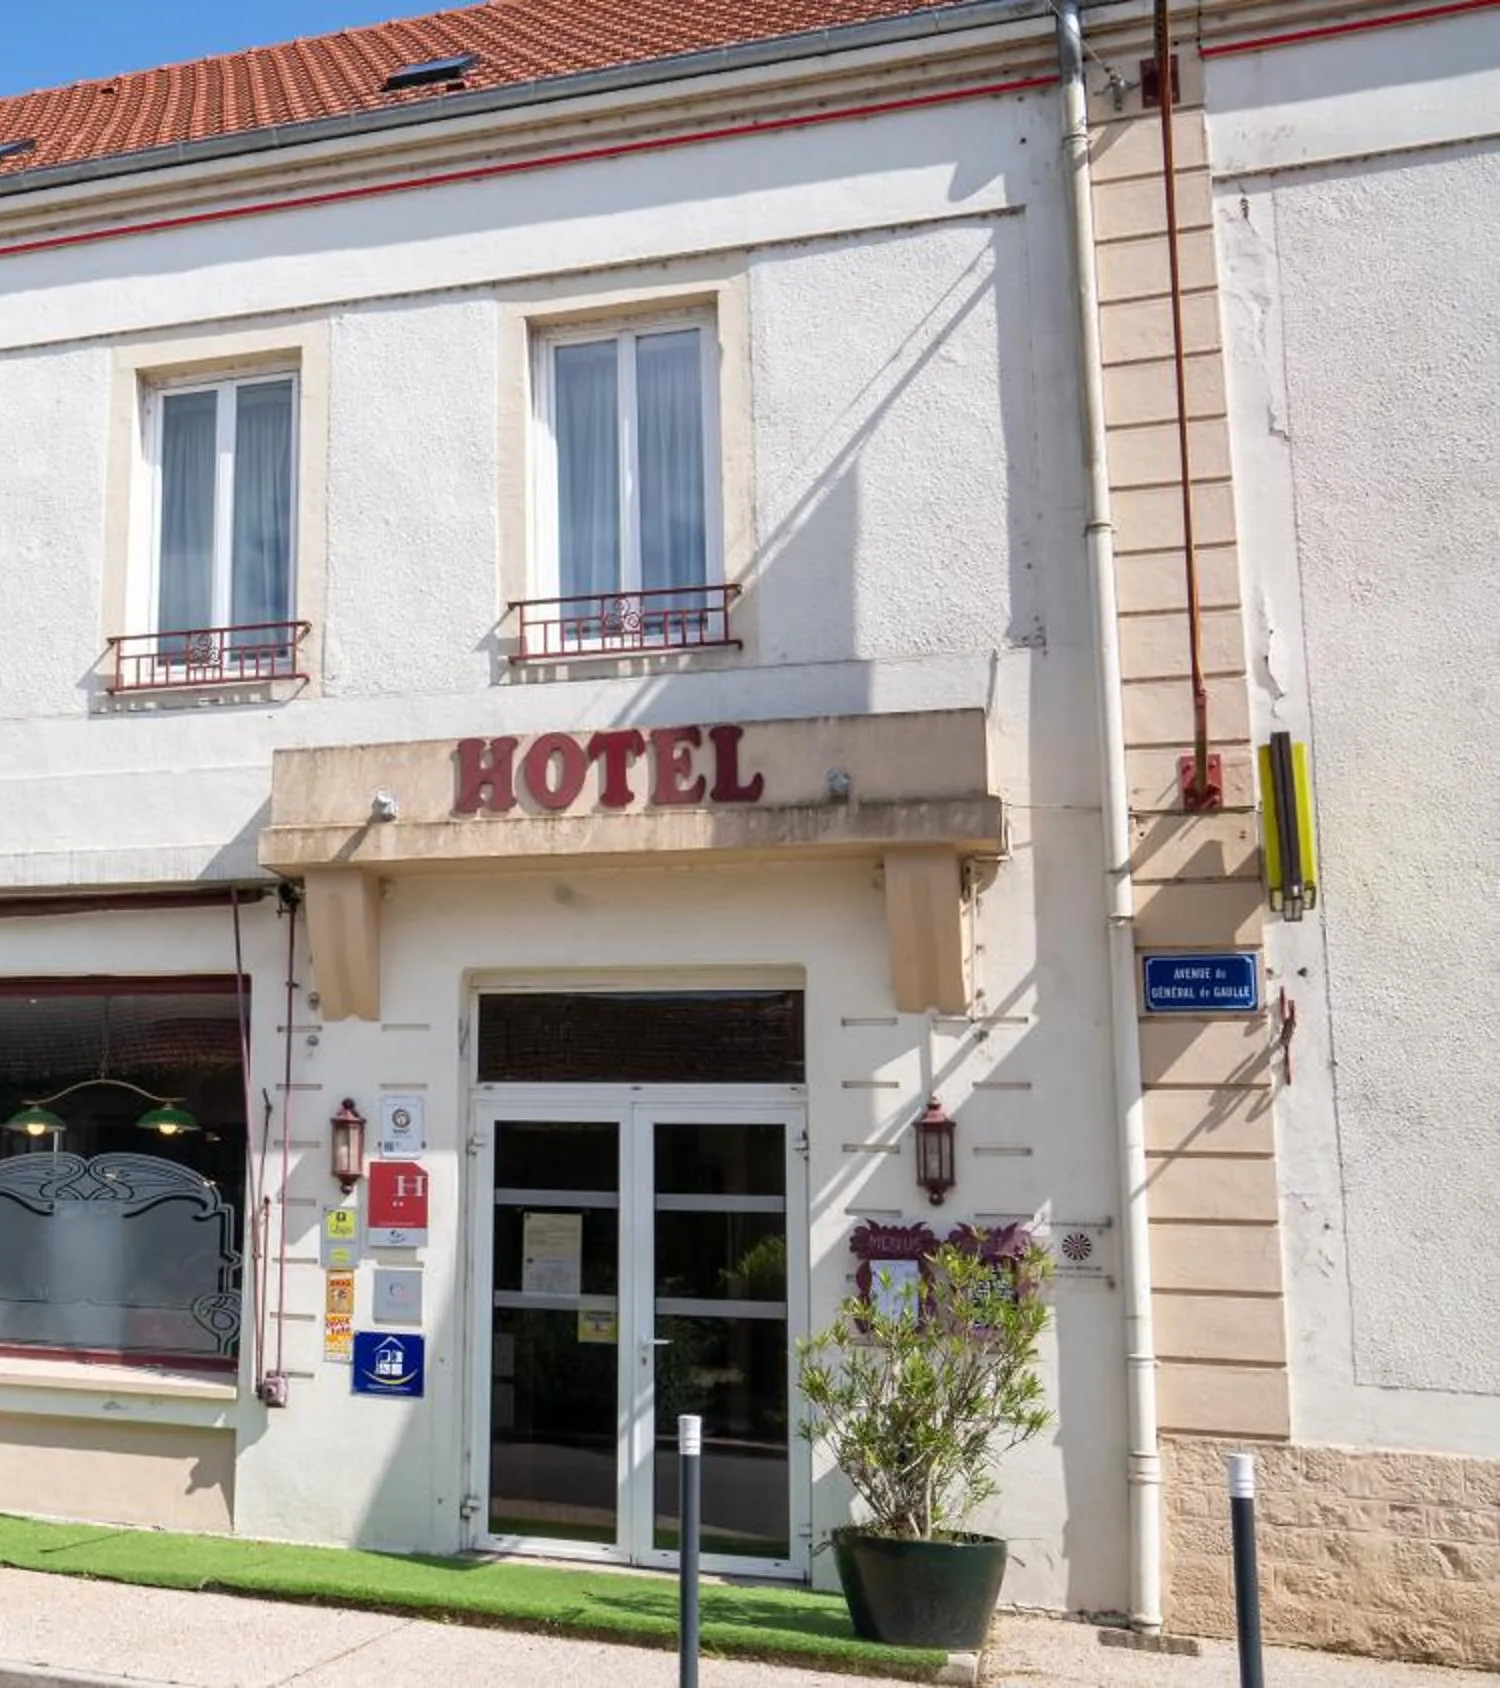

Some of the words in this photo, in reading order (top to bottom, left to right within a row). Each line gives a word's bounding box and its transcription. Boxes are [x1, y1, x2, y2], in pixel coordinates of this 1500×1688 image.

[450, 724, 764, 815] HOTEL
[1173, 967, 1211, 980] AVENUE
[1151, 984, 1195, 999] GÉNÉRAL
[1213, 986, 1251, 998] GAULLE
[394, 1174, 427, 1197] H
